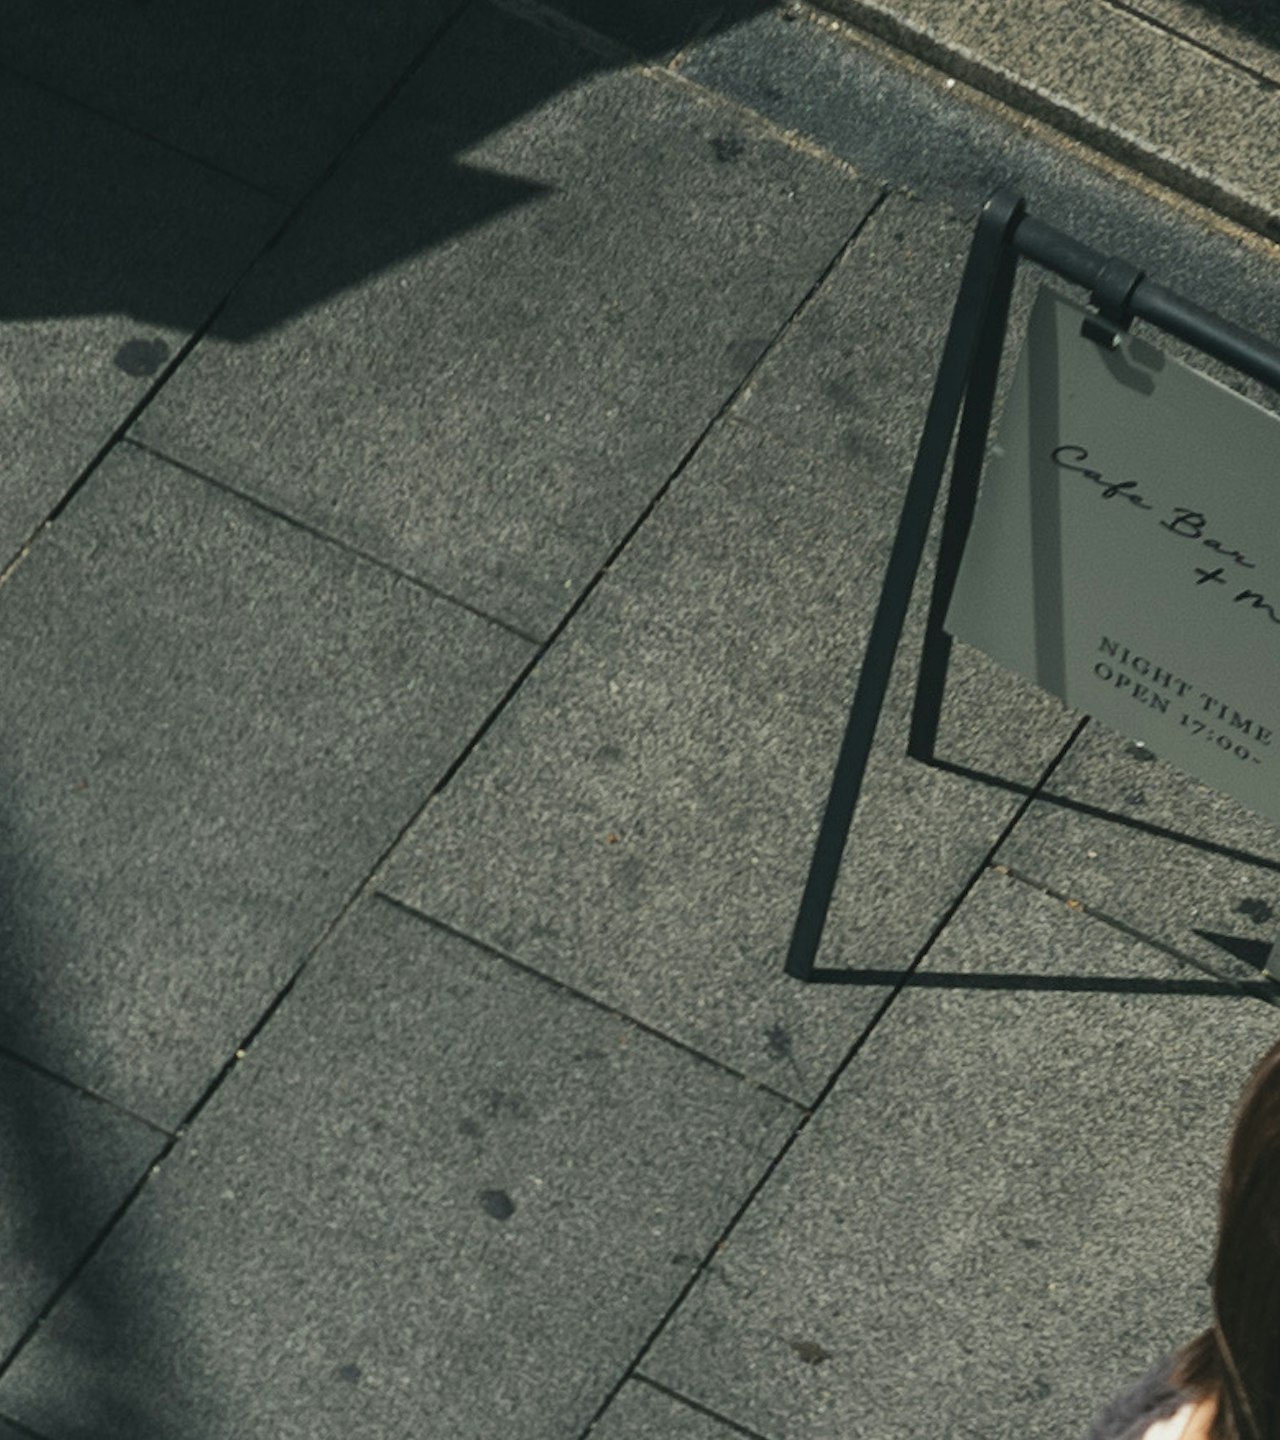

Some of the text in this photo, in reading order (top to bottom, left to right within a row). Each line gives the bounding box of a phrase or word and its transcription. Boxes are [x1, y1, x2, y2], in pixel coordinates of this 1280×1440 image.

[1051, 444, 1257, 570] Cafe Bar
[1091, 659, 1171, 716] OPEN
[1097, 634, 1276, 749] NIGHT TIME
